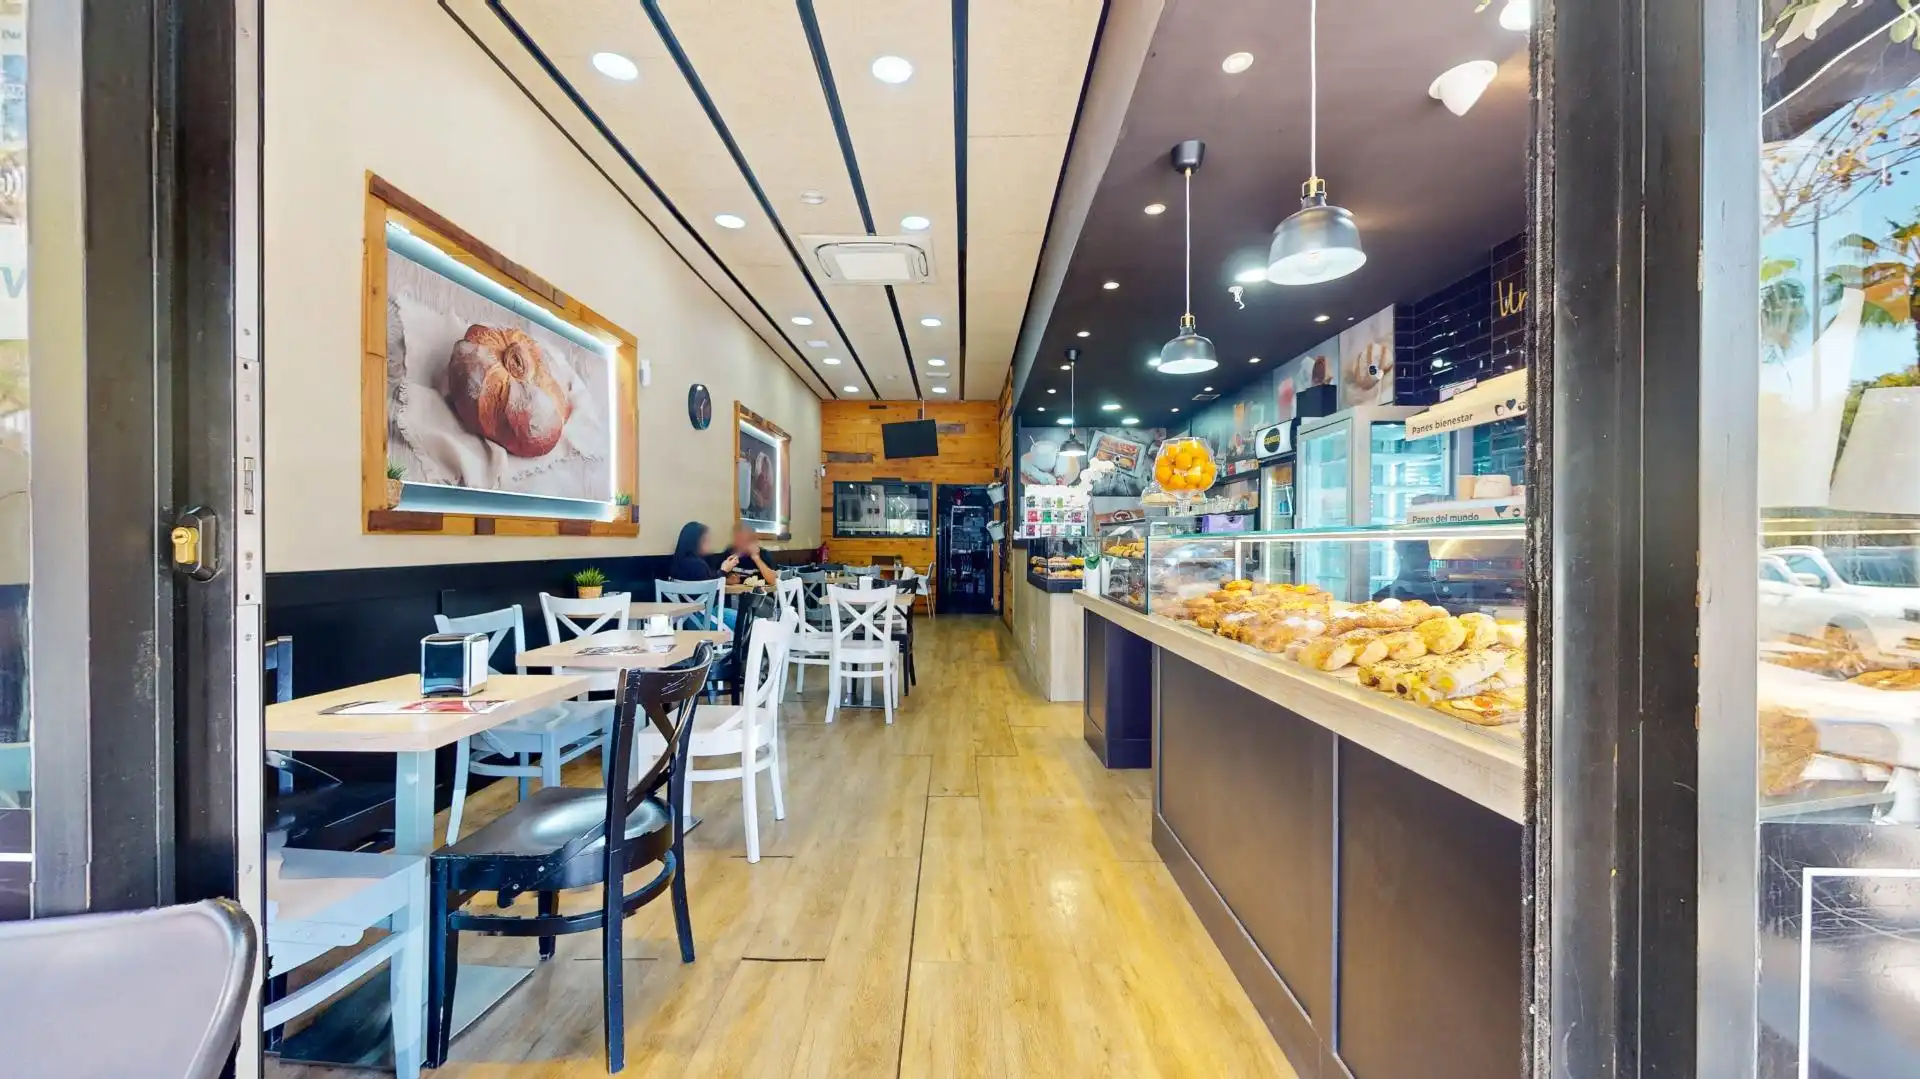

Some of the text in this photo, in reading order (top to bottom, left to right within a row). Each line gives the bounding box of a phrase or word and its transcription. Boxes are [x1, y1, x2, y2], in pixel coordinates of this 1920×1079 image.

[1411, 413, 1474, 435] Panes bienestar
[1412, 513, 1480, 524] Panes del mundo
